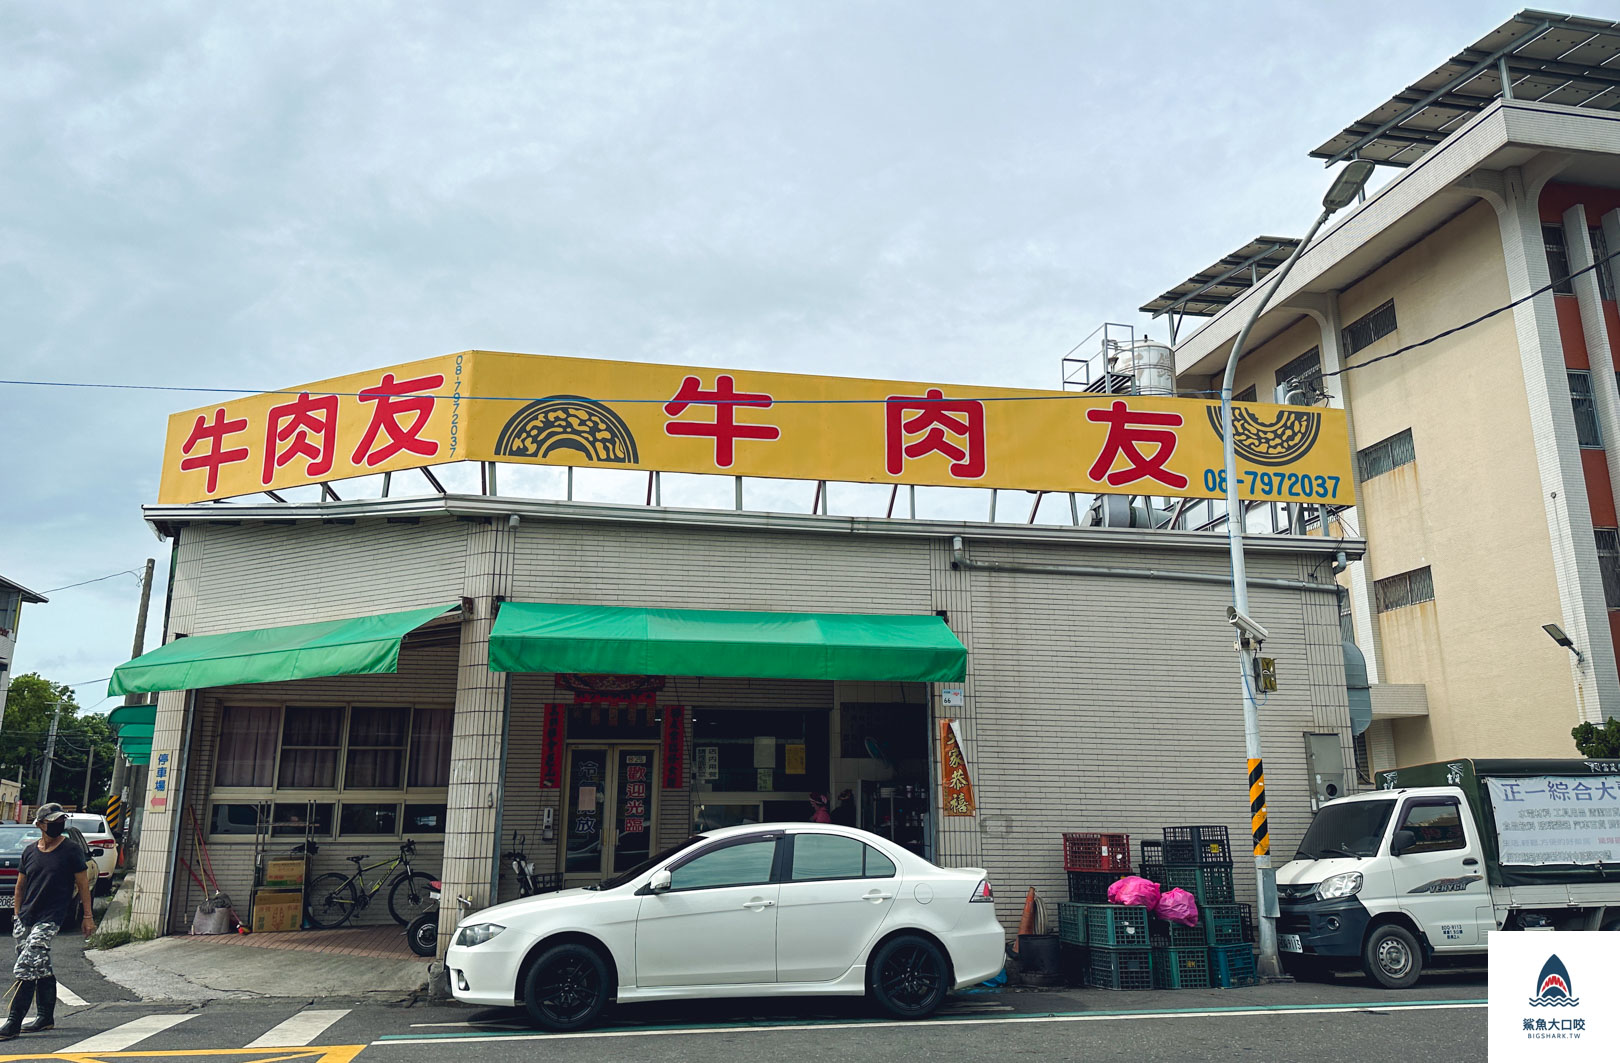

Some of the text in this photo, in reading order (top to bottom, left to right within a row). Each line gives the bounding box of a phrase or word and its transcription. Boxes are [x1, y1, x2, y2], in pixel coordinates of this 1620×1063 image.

[180, 373, 445, 494] 牛肉友
[450, 355, 463, 458] 08-7972037
[662, 374, 1189, 490] 牛肉友
[1203, 468, 1341, 499] 08-7972037
[155, 753, 169, 791] 停車場
[576, 760, 598, 833] 冷放
[625, 765, 646, 833] 歡迎光臨
[1500, 780, 1620, 802] 正一綜合大
